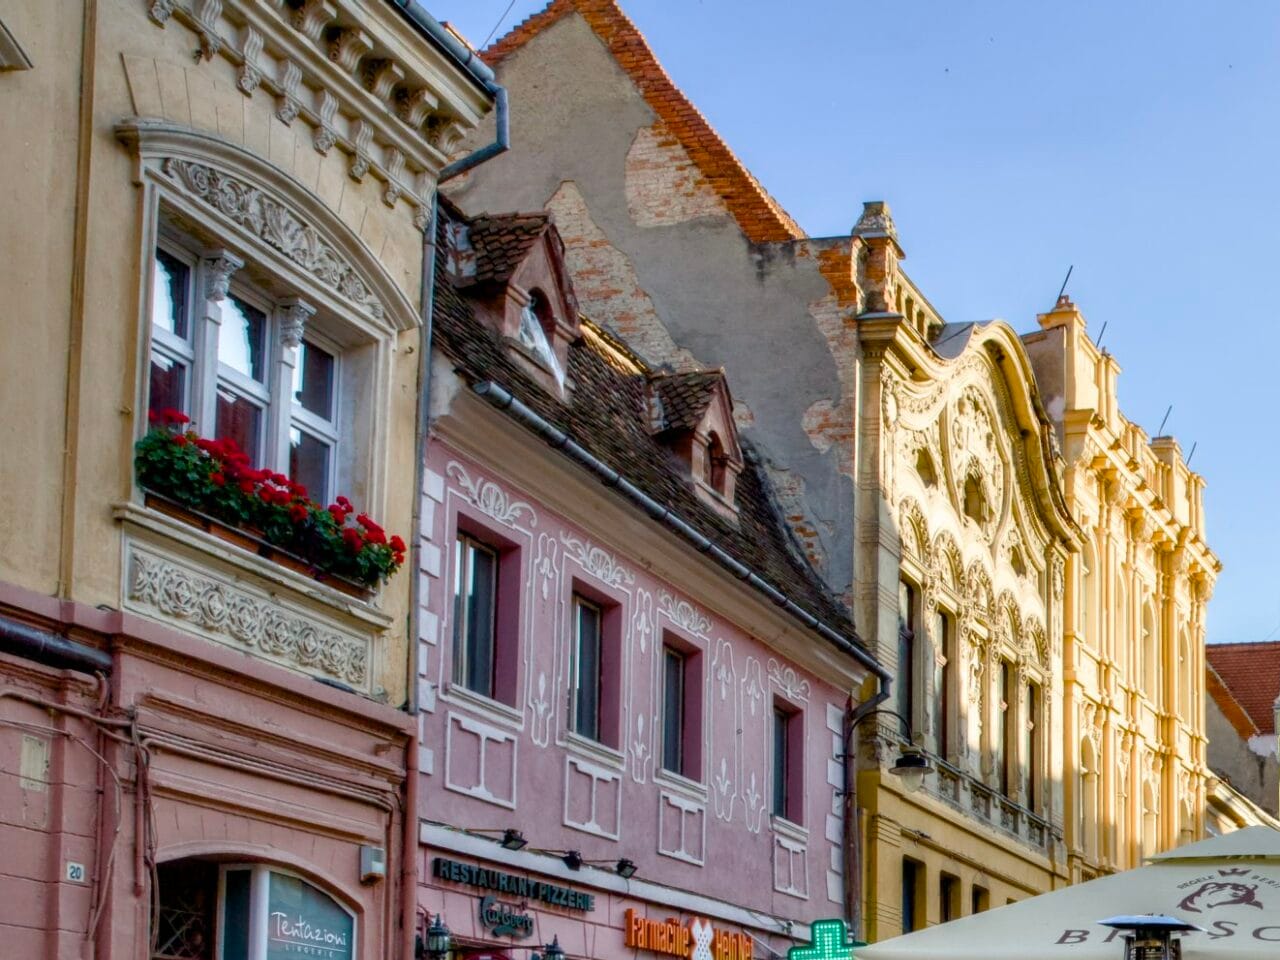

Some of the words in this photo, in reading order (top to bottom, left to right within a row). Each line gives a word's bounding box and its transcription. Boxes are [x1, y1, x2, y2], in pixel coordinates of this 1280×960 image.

[70, 865, 82, 880] 20
[437, 859, 537, 898] RESTAURANT
[538, 882, 596, 912] PIZZERIE
[271, 911, 347, 946] Tentazioni
[627, 909, 690, 957] Farmaciile
